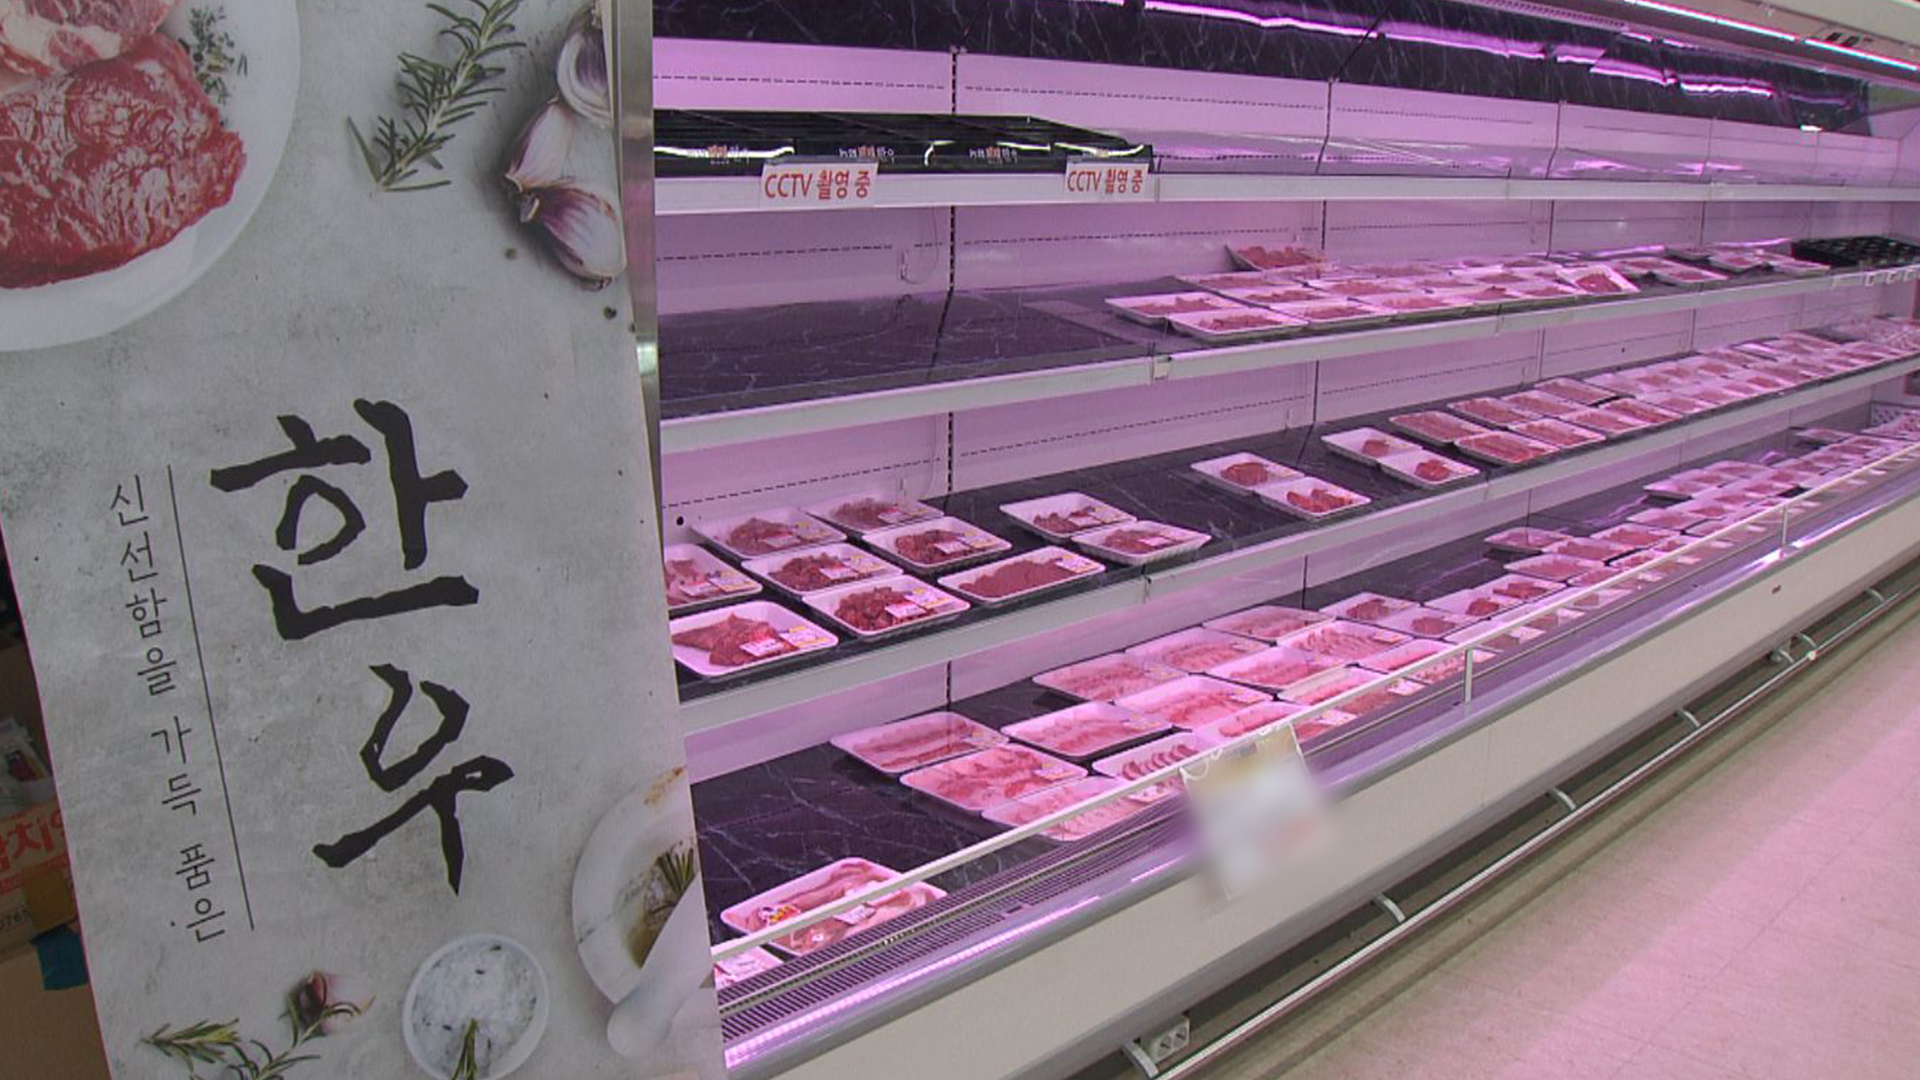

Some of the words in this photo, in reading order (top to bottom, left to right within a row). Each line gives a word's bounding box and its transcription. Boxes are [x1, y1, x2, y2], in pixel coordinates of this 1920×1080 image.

[765, 173, 813, 199] CCTV
[817, 170, 851, 200] 촬영
[855, 170, 871, 199] 중
[1067, 171, 1102, 192] CCTV
[1105, 169, 1129, 193] 촬영
[1132, 169, 1144, 193] 중
[110, 474, 177, 697] 신선함을
[211, 399, 513, 895] 한우
[151, 716, 202, 816] 가득
[176, 844, 226, 943] 품은
